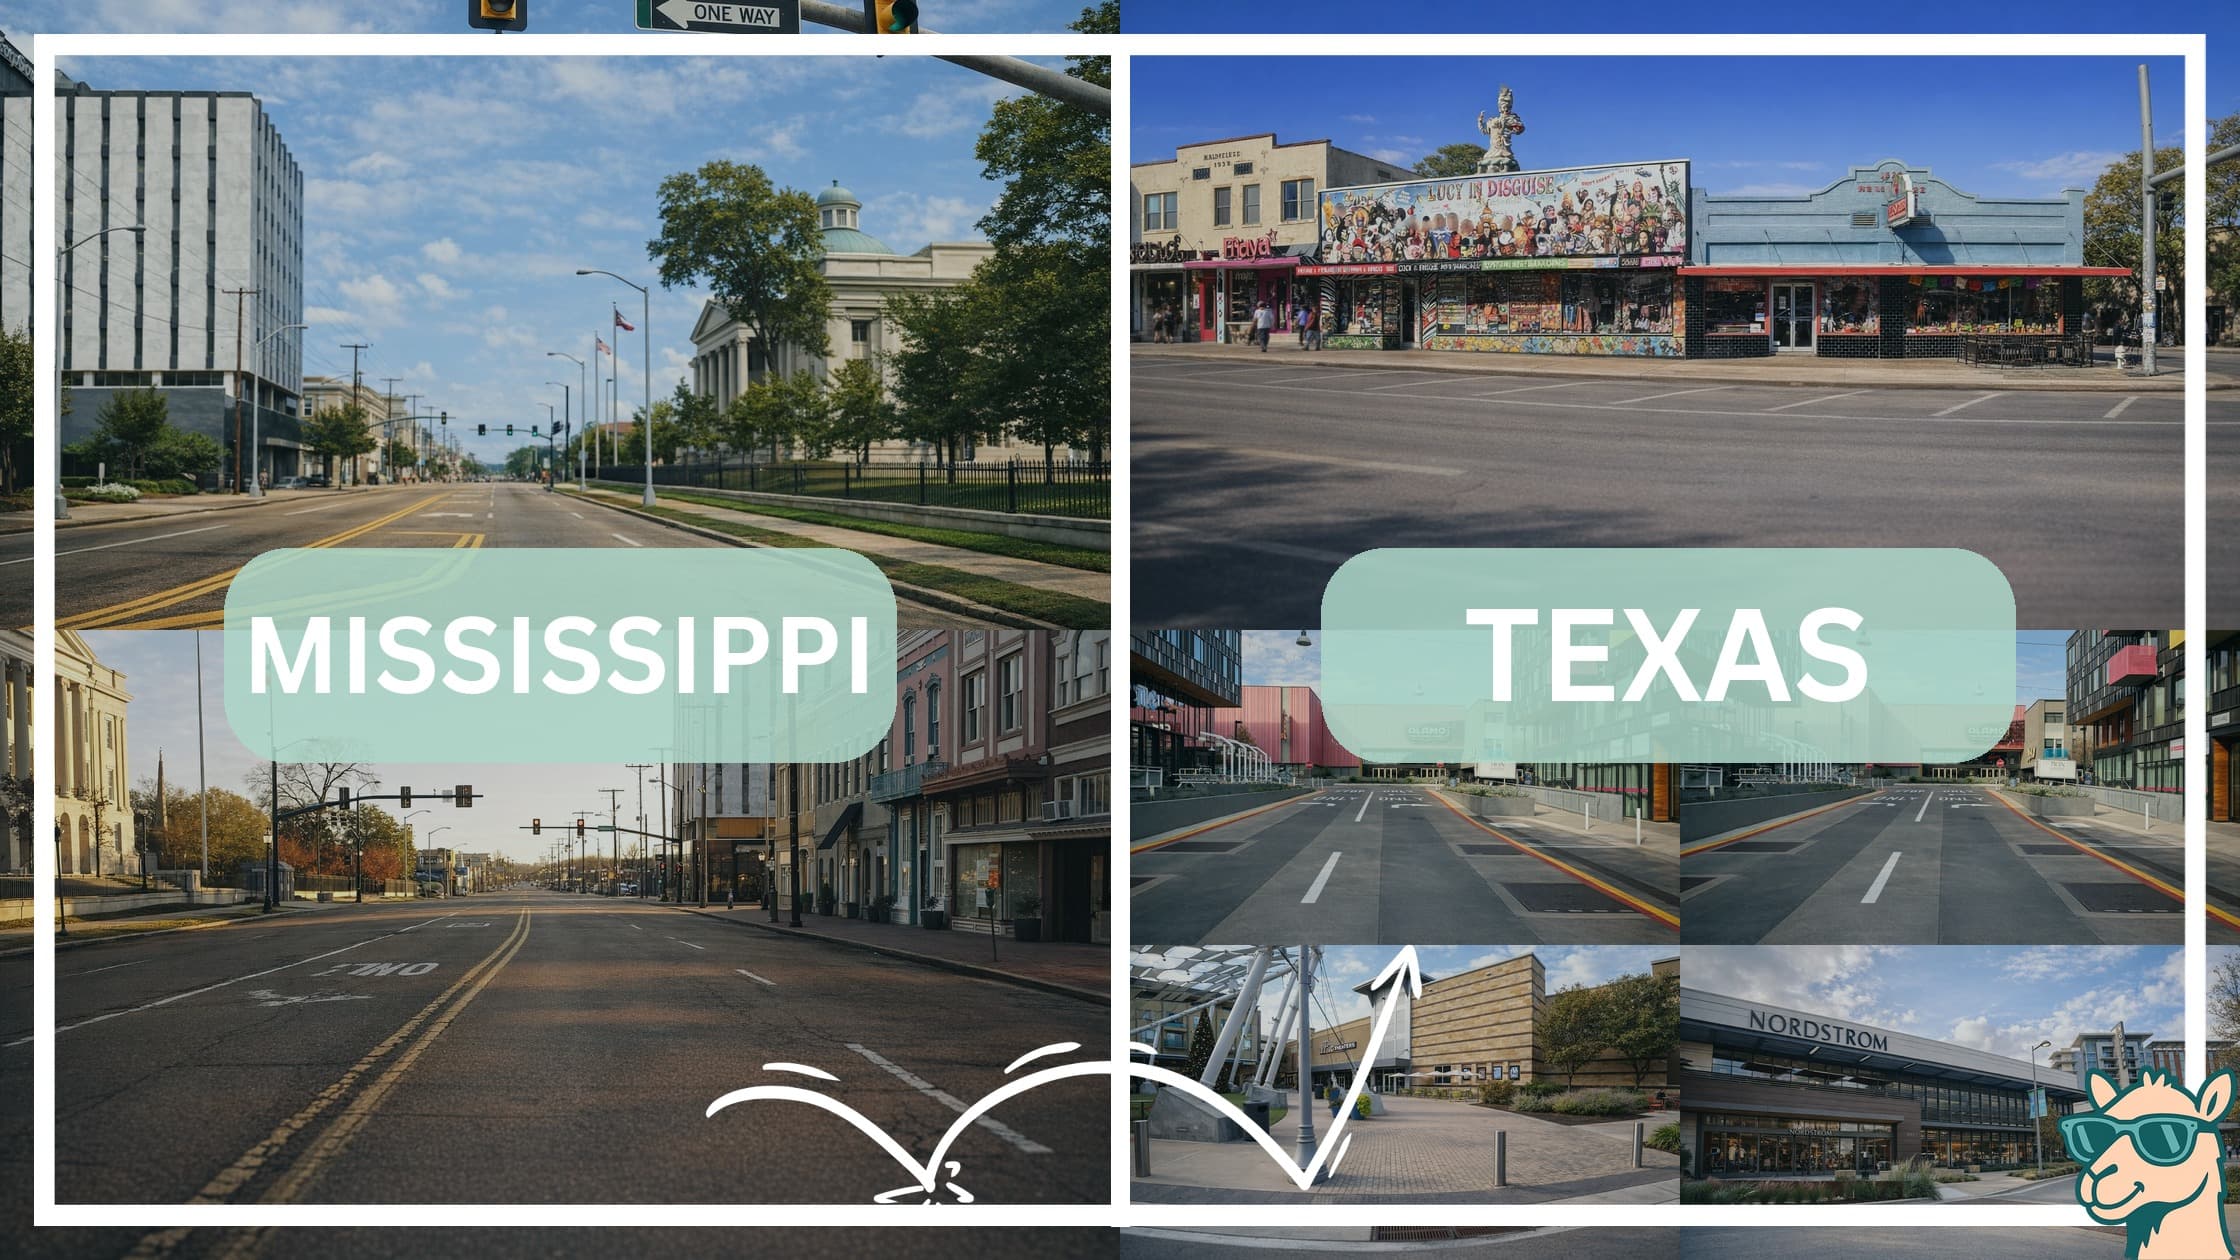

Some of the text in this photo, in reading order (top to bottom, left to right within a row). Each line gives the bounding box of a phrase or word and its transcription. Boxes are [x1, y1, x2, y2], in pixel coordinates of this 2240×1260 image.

[694, 4, 776, 25] ONE WAY
[1426, 182, 1464, 201] LUCY
[1469, 181, 1483, 199] IN
[1487, 176, 1554, 198] DISGUISE
[1750, 1009, 1889, 1052] NORDSTROM
